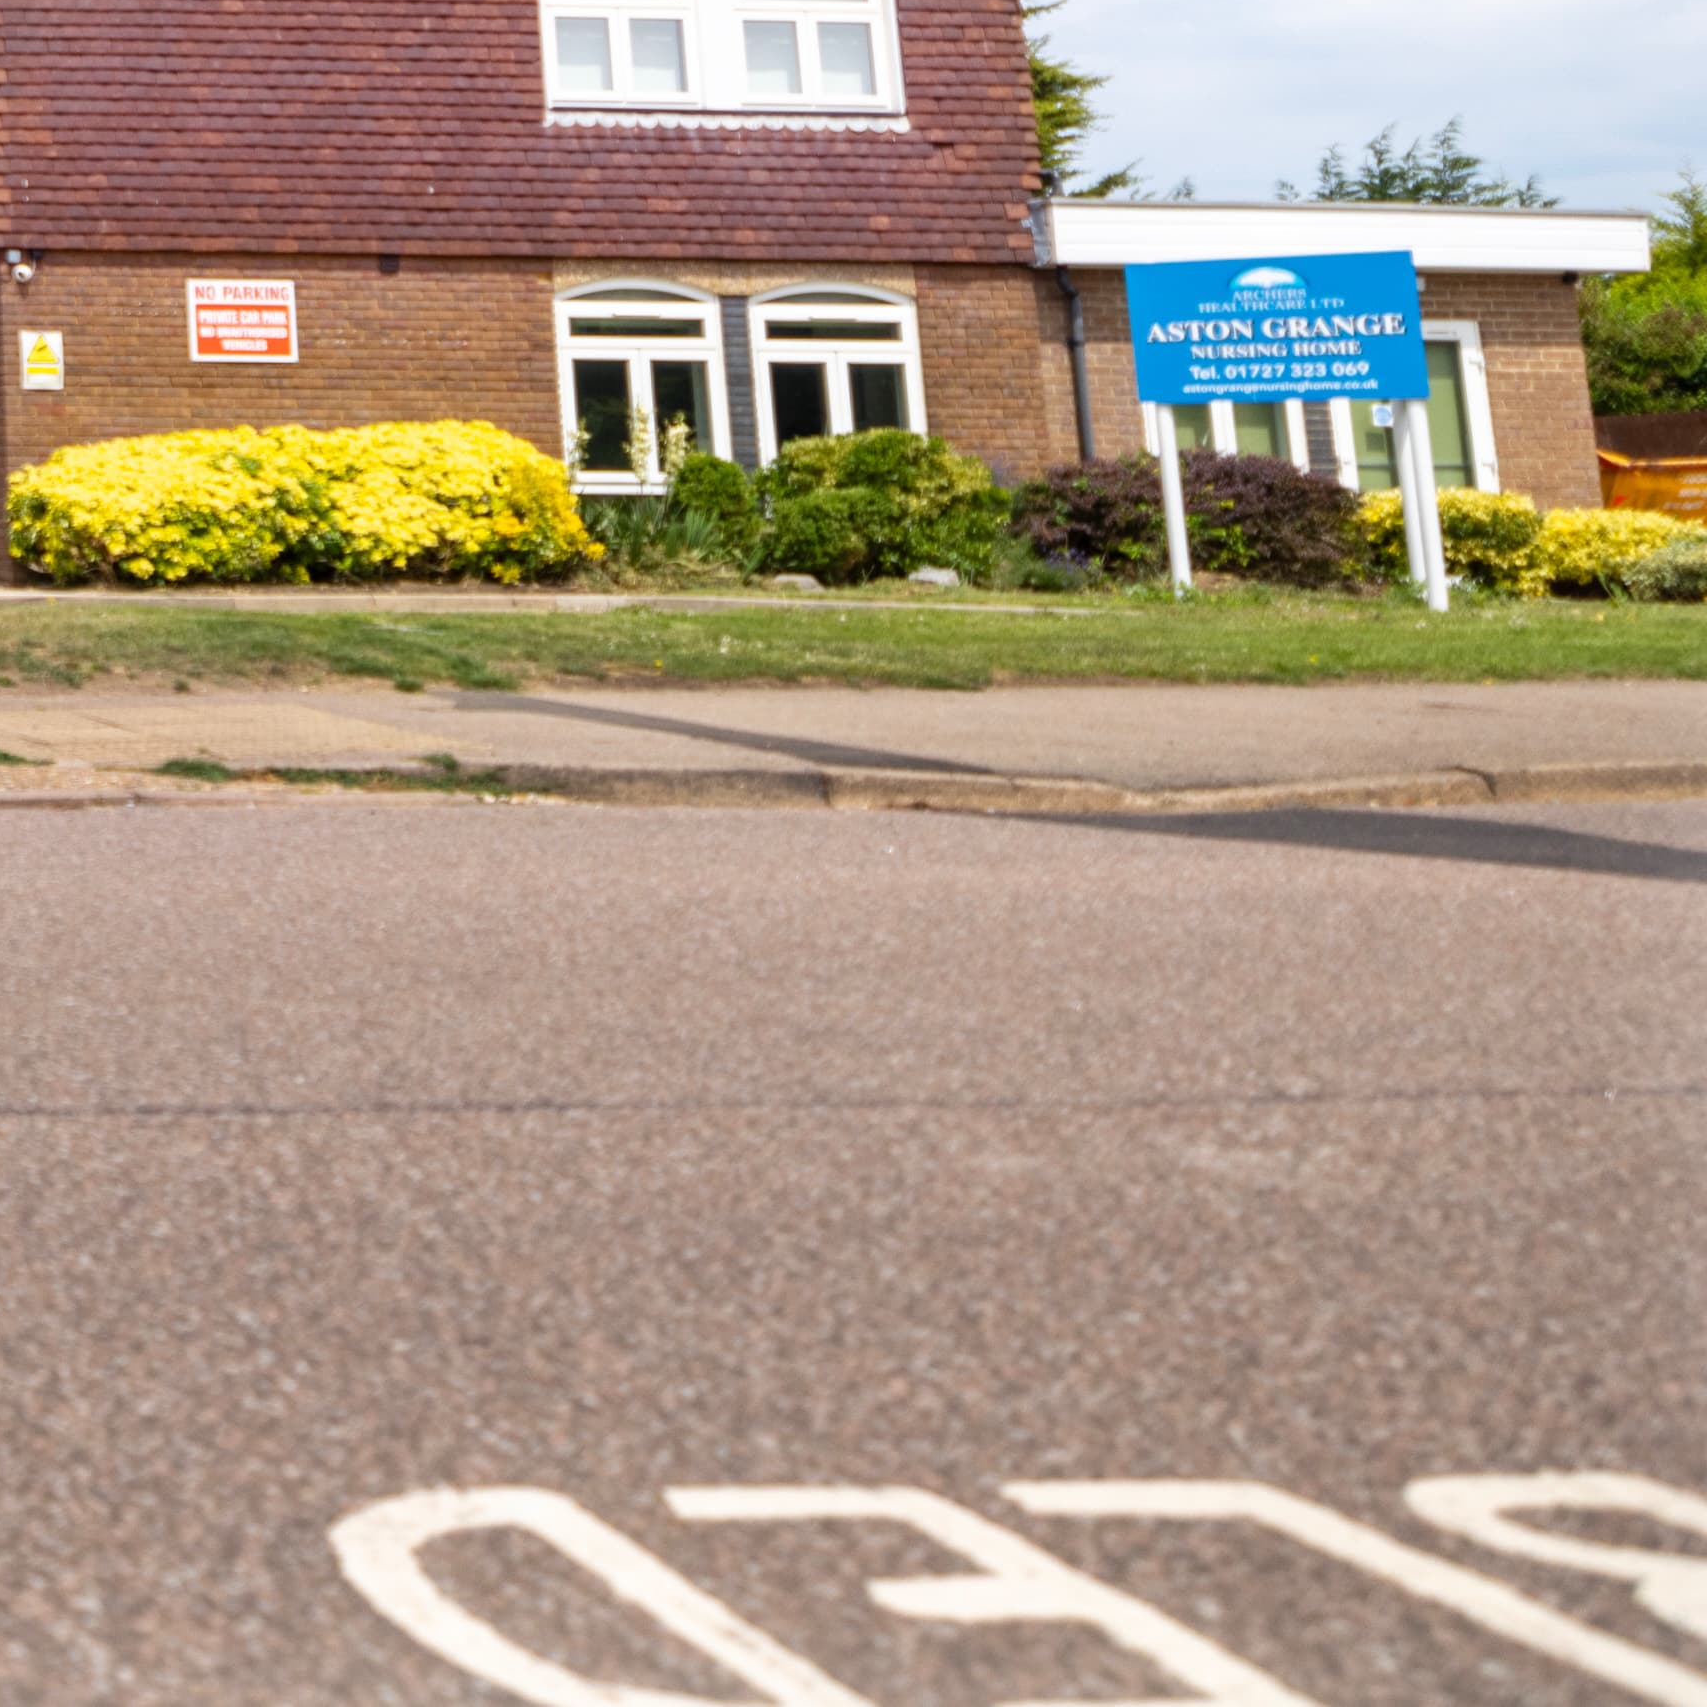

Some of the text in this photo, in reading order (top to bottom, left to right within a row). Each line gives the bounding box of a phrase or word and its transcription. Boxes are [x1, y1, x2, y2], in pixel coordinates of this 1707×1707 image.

[195, 286, 289, 301] NO PARKING
[1232, 288, 1307, 301] ARCHERS
[1198, 298, 1345, 314] HEALTHCARE LTD
[199, 310, 288, 324] PRIVATE CAR PARK
[1146, 313, 1407, 344] ASTON GRANGE
[221, 339, 268, 351] VEHICLES
[1191, 340, 1362, 360] NURSING HOME
[1189, 362, 1369, 380] Tel. 01727 323 069
[1183, 379, 1378, 395] astongrangenursinghome.co.uk
